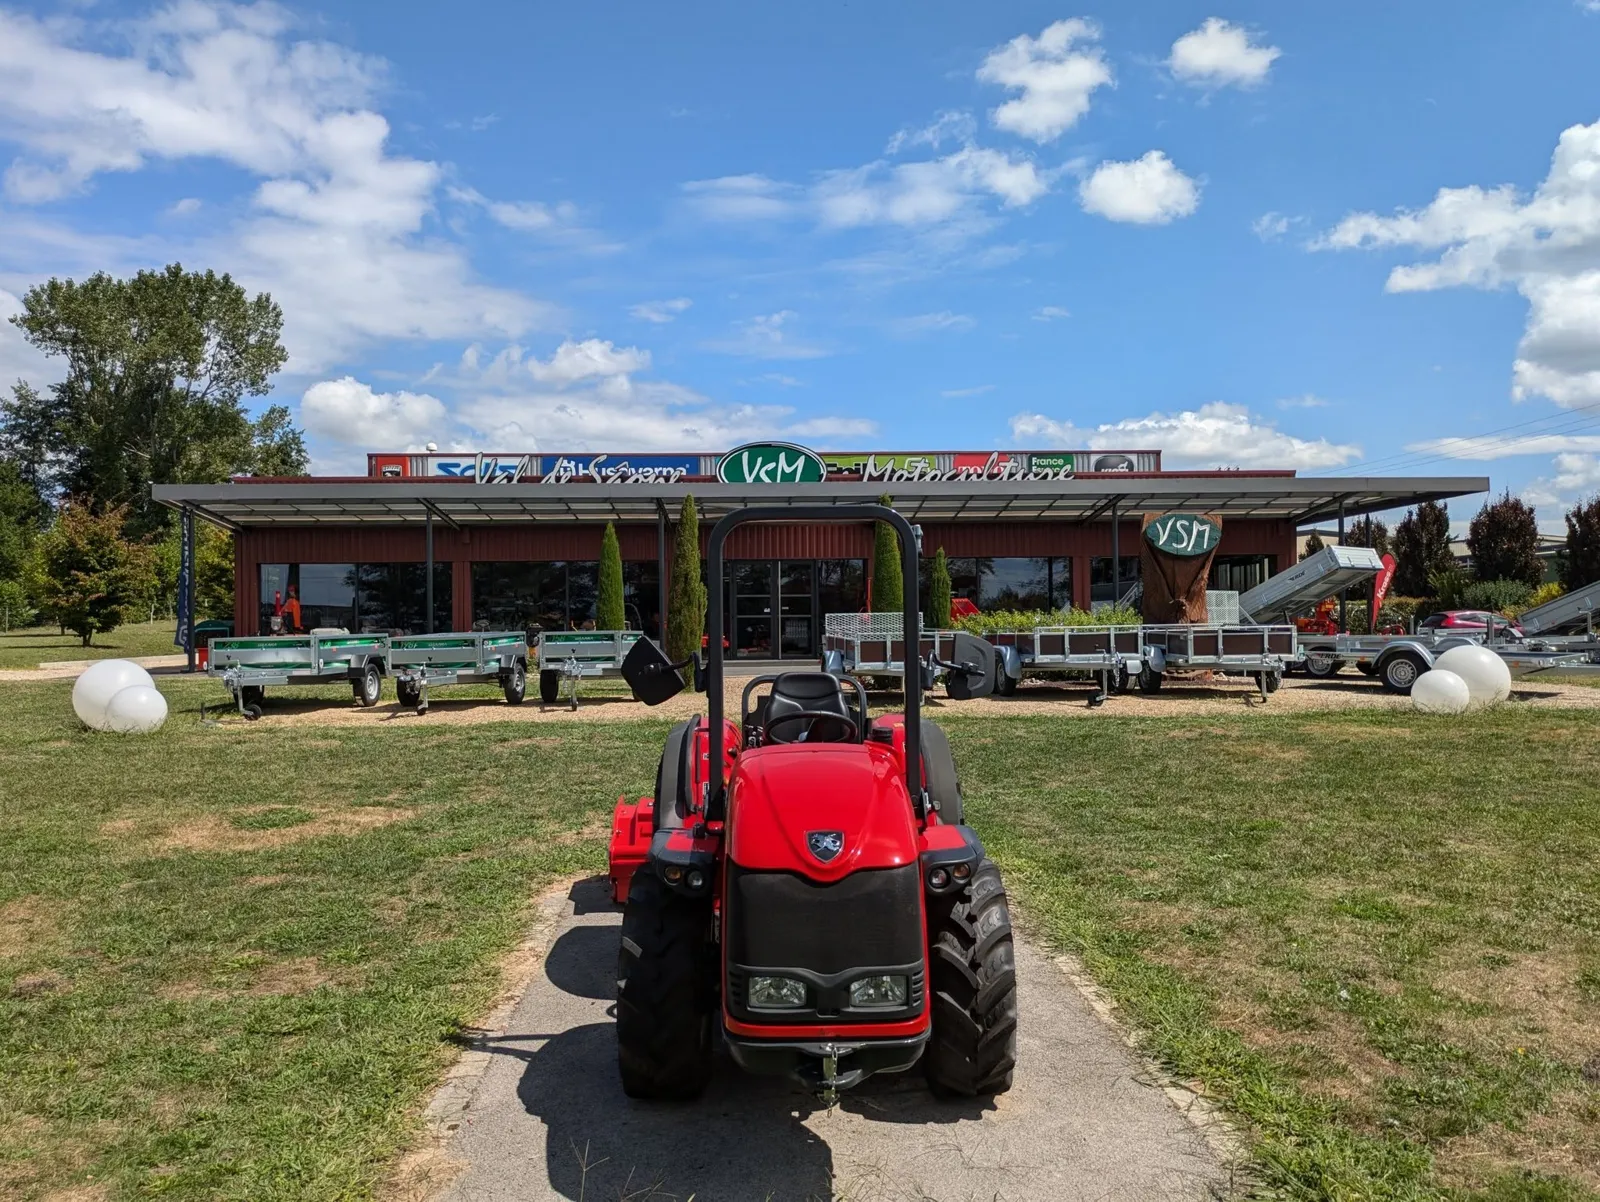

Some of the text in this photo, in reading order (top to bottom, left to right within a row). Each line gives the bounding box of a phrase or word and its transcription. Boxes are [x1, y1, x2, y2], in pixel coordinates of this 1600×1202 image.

[475, 452, 530, 484] Val
[1031, 456, 1064, 466] France
[1156, 517, 1211, 552] VSM
[1319, 652, 1343, 660] ERDE
